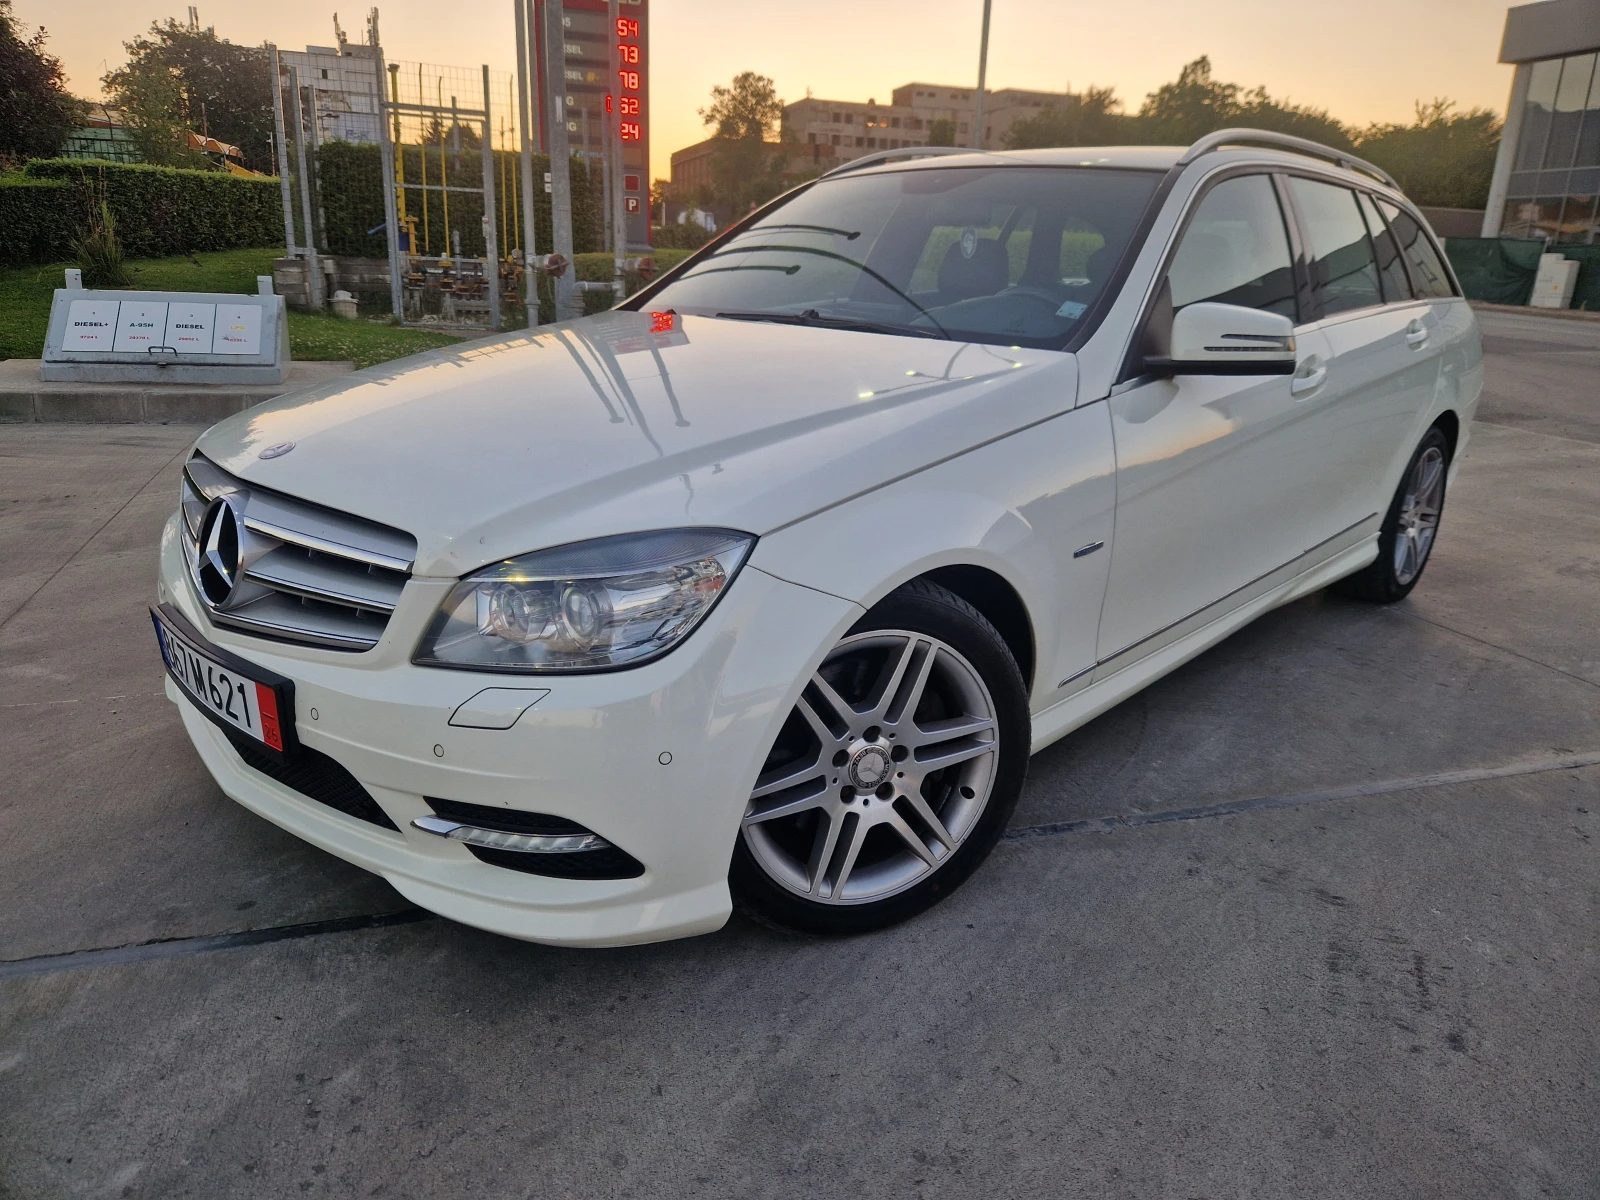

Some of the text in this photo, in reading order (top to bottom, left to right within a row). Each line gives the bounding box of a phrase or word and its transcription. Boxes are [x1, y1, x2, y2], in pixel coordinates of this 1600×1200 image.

[617, 19, 639, 37] 54
[618, 45, 639, 63] 73
[618, 71, 639, 89] 78
[628, 199, 637, 210] P
